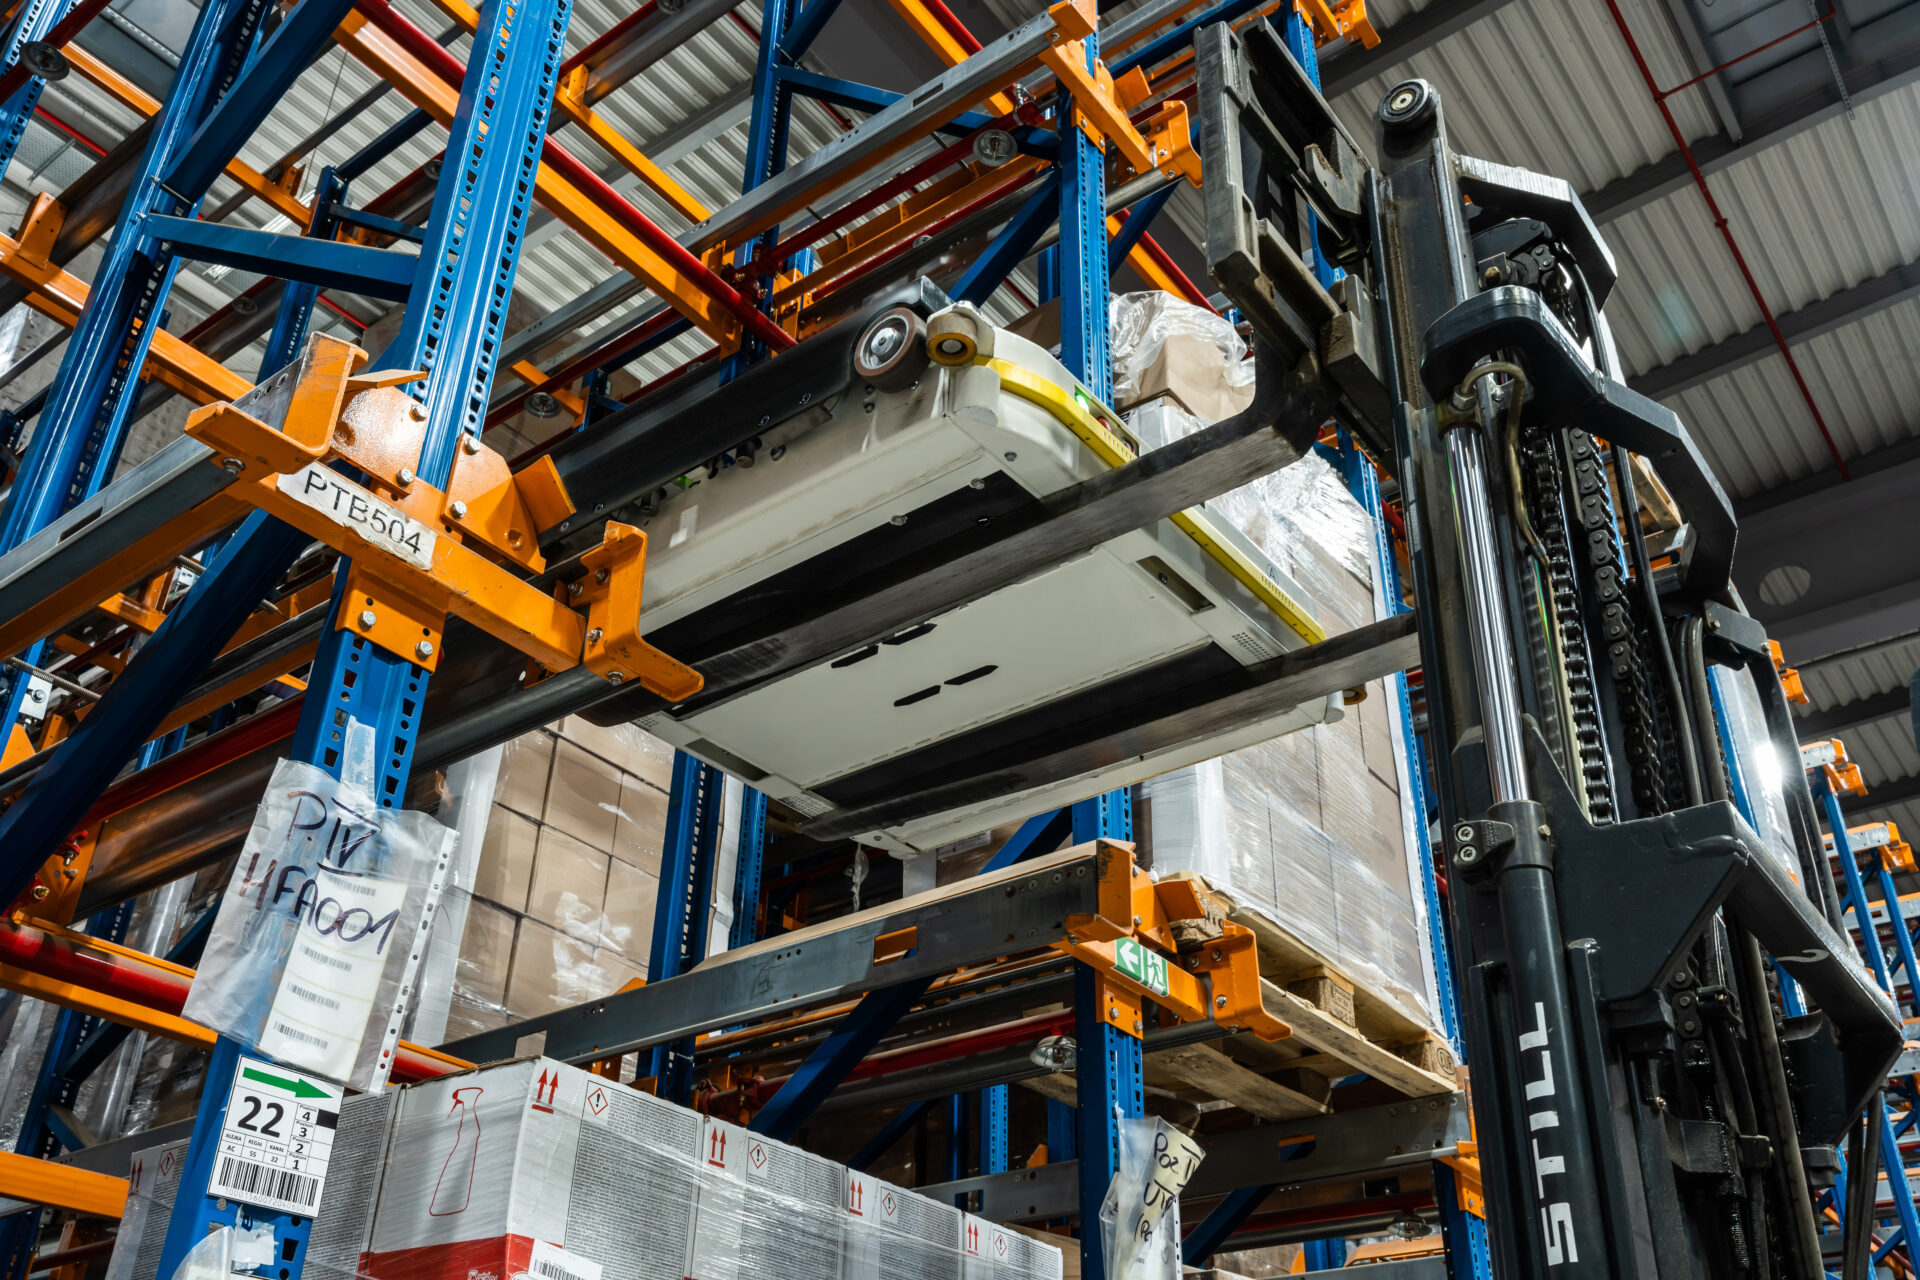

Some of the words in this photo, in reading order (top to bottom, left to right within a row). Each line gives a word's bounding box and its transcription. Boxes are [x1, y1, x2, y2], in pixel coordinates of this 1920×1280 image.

[304, 470, 421, 553] PTB504
[240, 852, 400, 954] HFA001
[238, 1096, 284, 1138] 22
[302, 1111, 311, 1121] 4
[299, 1127, 307, 1137] 3
[1519, 1001, 1578, 1266] STILL
[295, 1143, 304, 1153] 2
[292, 1159, 299, 1170] 1
